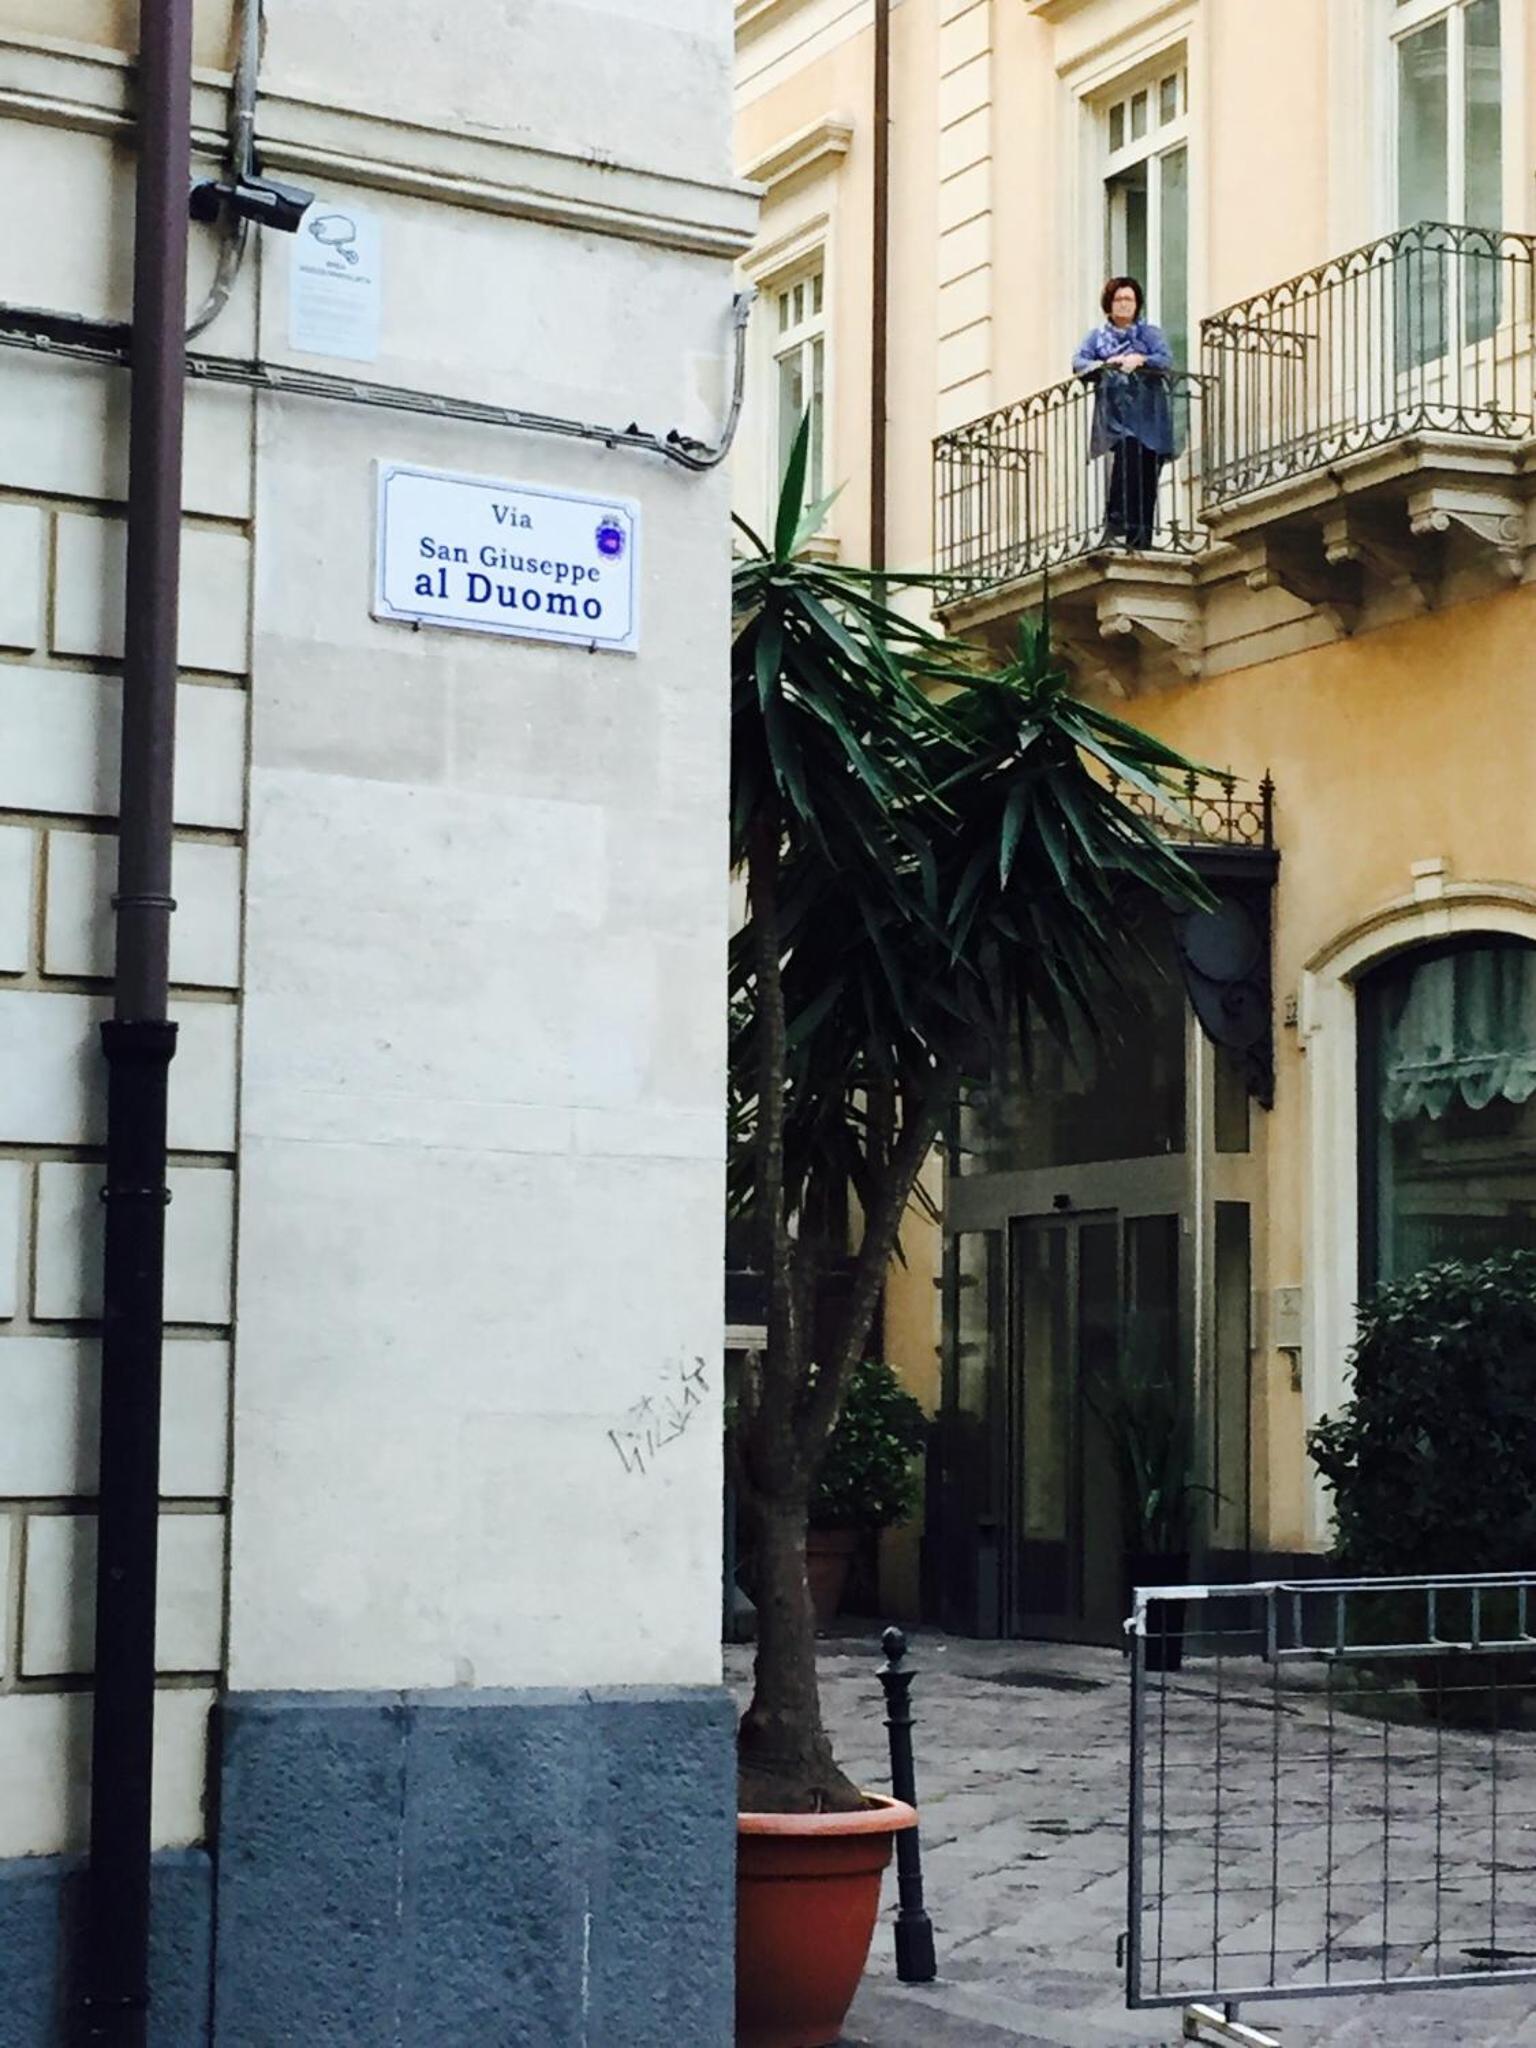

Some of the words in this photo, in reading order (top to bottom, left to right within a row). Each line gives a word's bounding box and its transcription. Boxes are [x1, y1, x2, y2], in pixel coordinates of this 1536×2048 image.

[491, 504, 533, 530] Via
[419, 536, 469, 564] San
[479, 545, 601, 586] Giuseppe
[414, 567, 449, 599] al
[466, 572, 602, 620] Duomo
